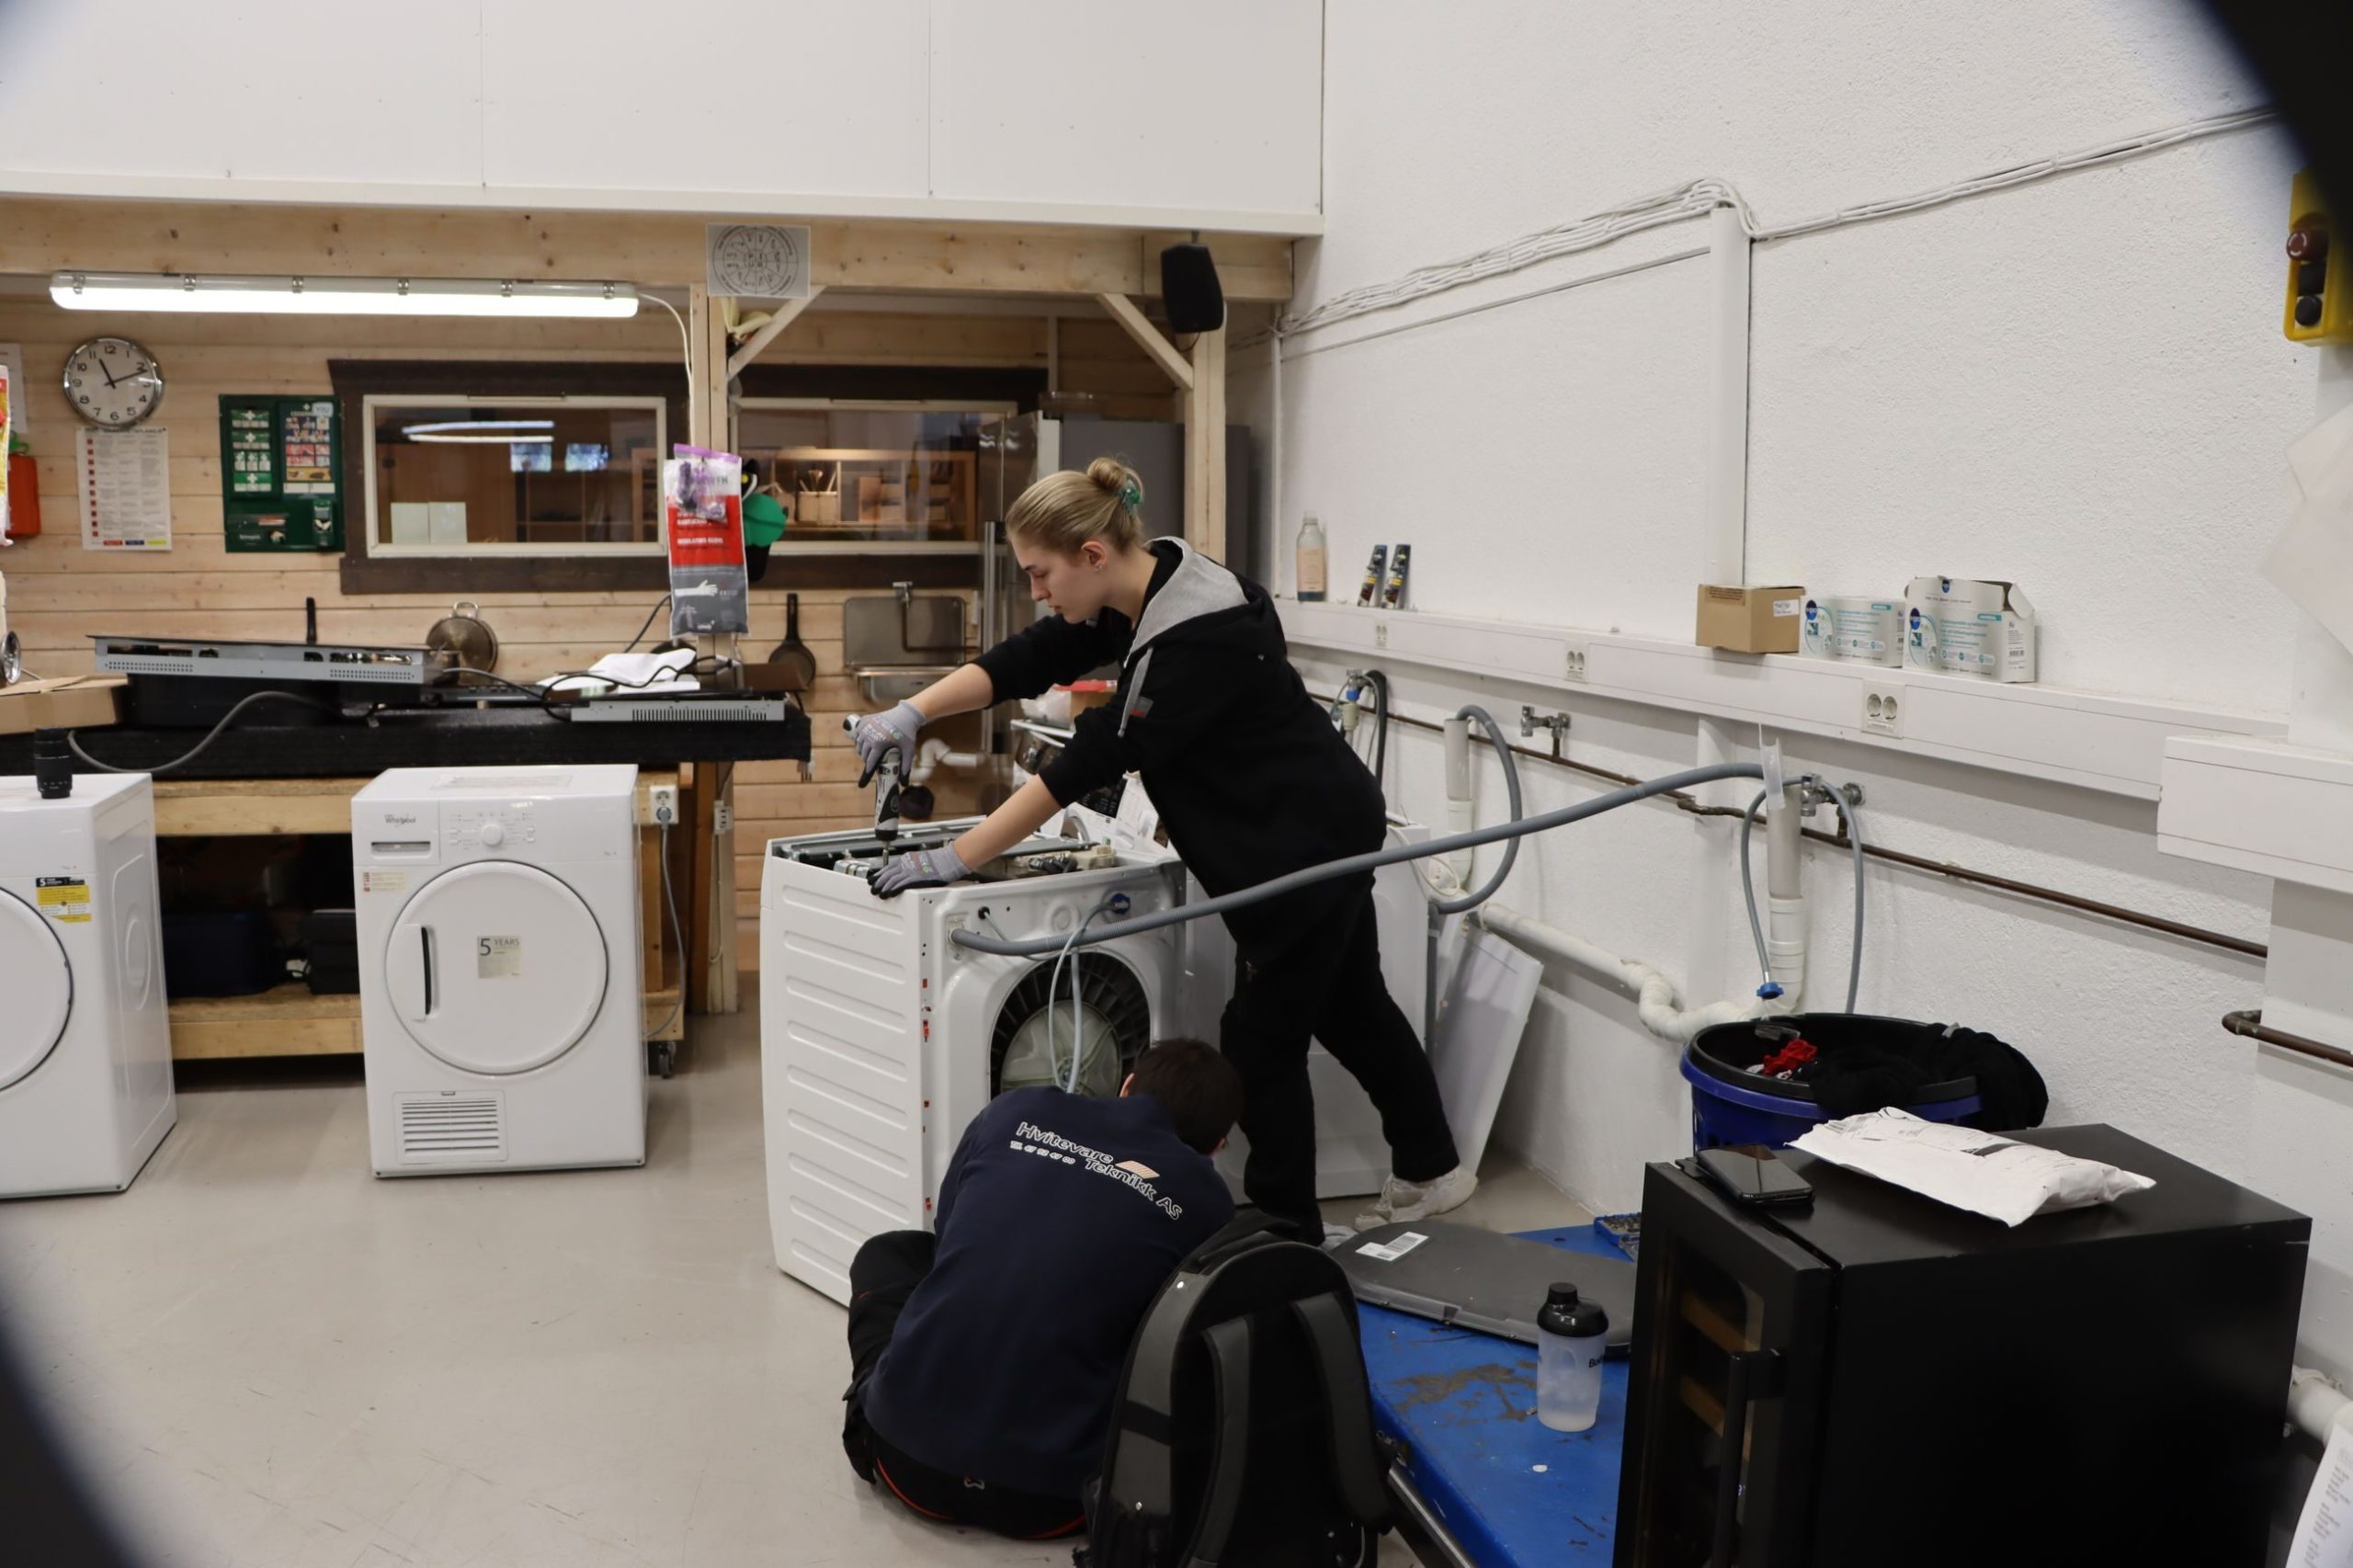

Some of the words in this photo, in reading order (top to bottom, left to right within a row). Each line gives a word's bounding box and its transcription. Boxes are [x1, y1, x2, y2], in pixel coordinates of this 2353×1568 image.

[88, 350, 97, 359] 11
[104, 345, 117, 355] 12
[126, 350, 130, 358] 1
[76, 362, 87, 371] 10
[73, 379, 82, 387] 9
[79, 395, 90, 404] 8
[139, 394, 147, 403] 4
[93, 407, 101, 416] 7
[127, 406, 136, 415] 5
[110, 412, 119, 421] 6
[480, 937, 492, 957] 5
[494, 937, 520, 947] YEARS
[1016, 1121, 1113, 1164] Hvitevare
[1085, 1157, 1158, 1202] Teknikk
[1155, 1197, 1183, 1221] AS
